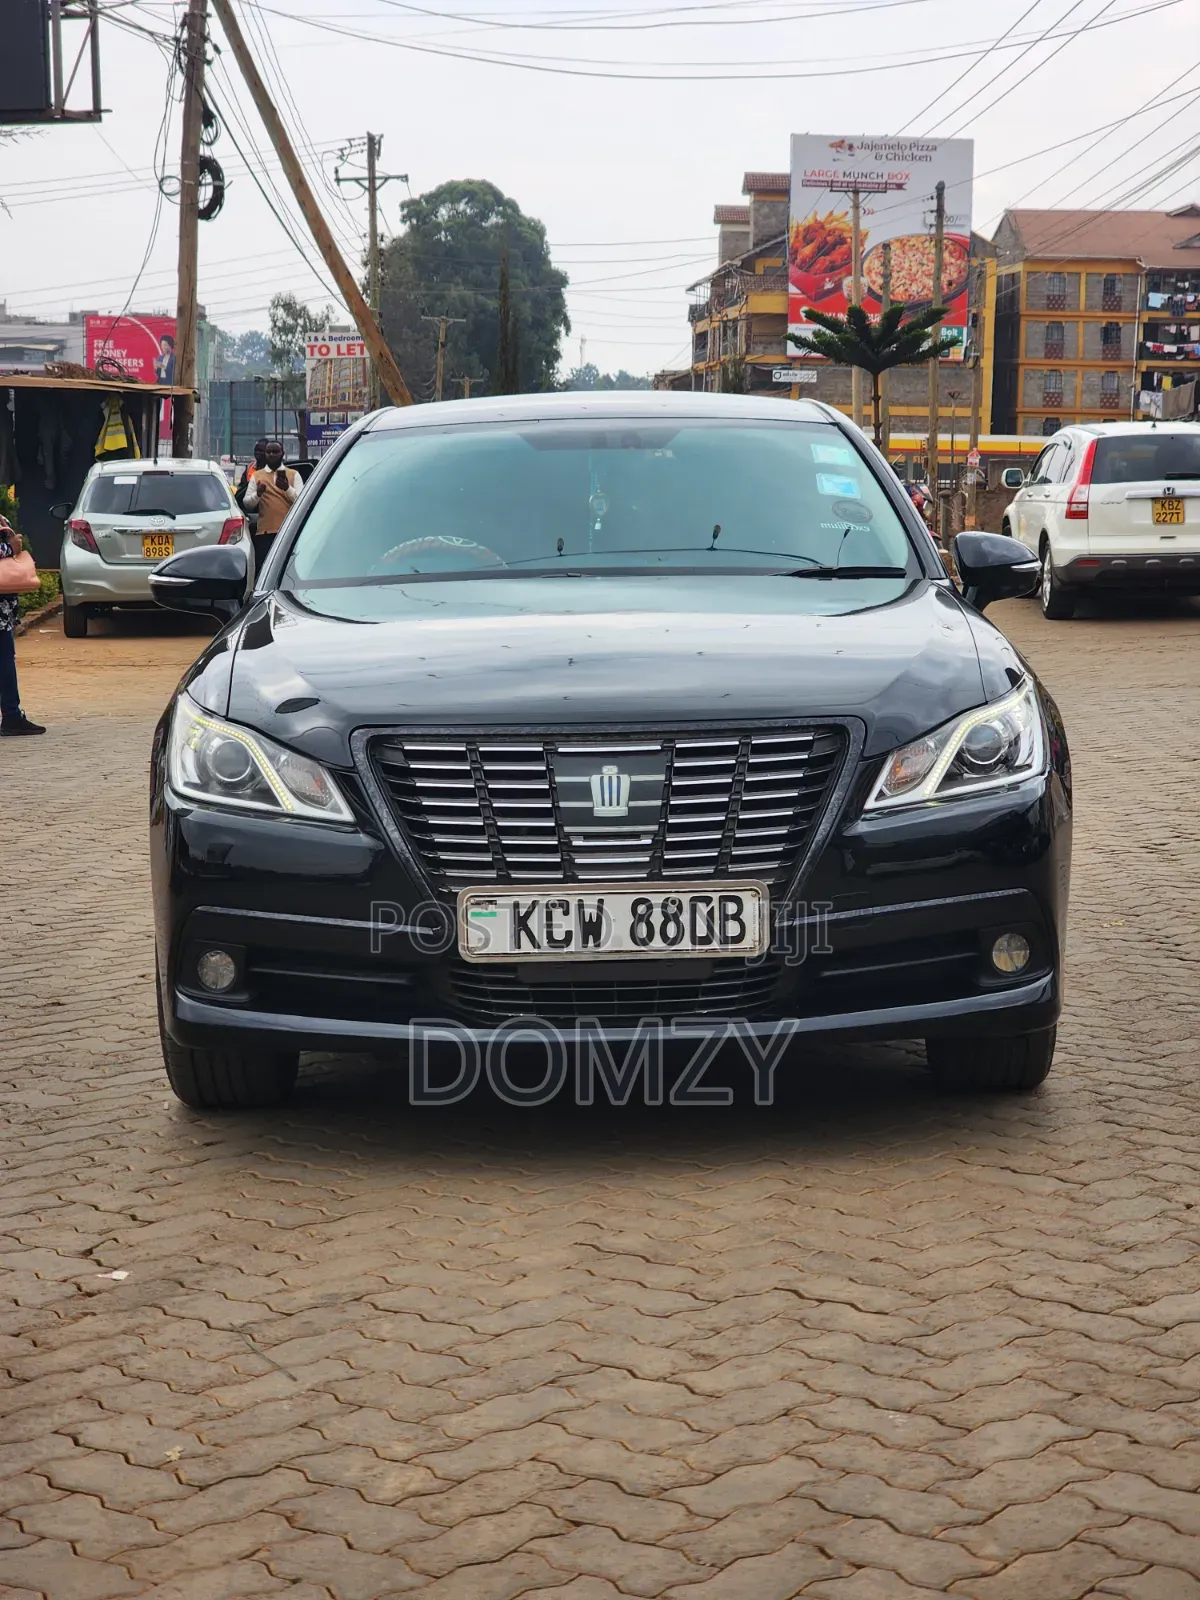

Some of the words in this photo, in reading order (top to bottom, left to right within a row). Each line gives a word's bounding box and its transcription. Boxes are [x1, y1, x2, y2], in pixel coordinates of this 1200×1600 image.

[909, 141, 938, 152] Pizza
[874, 152, 884, 161] &
[885, 151, 932, 162] Chicken
[803, 169, 839, 179] LARGE
[843, 171, 884, 180] MUNCH
[887, 172, 911, 181] BOX
[941, 327, 958, 336] Bolt
[93, 339, 114, 349] FREE
[93, 349, 128, 357] MONEY
[306, 344, 331, 357] TO
[336, 343, 365, 356] LET
[1160, 500, 1181, 511] KBZ
[1155, 512, 1181, 523] 227T
[150, 535, 170, 546] KDA
[145, 547, 170, 557] 898S
[513, 898, 604, 949] KCW
